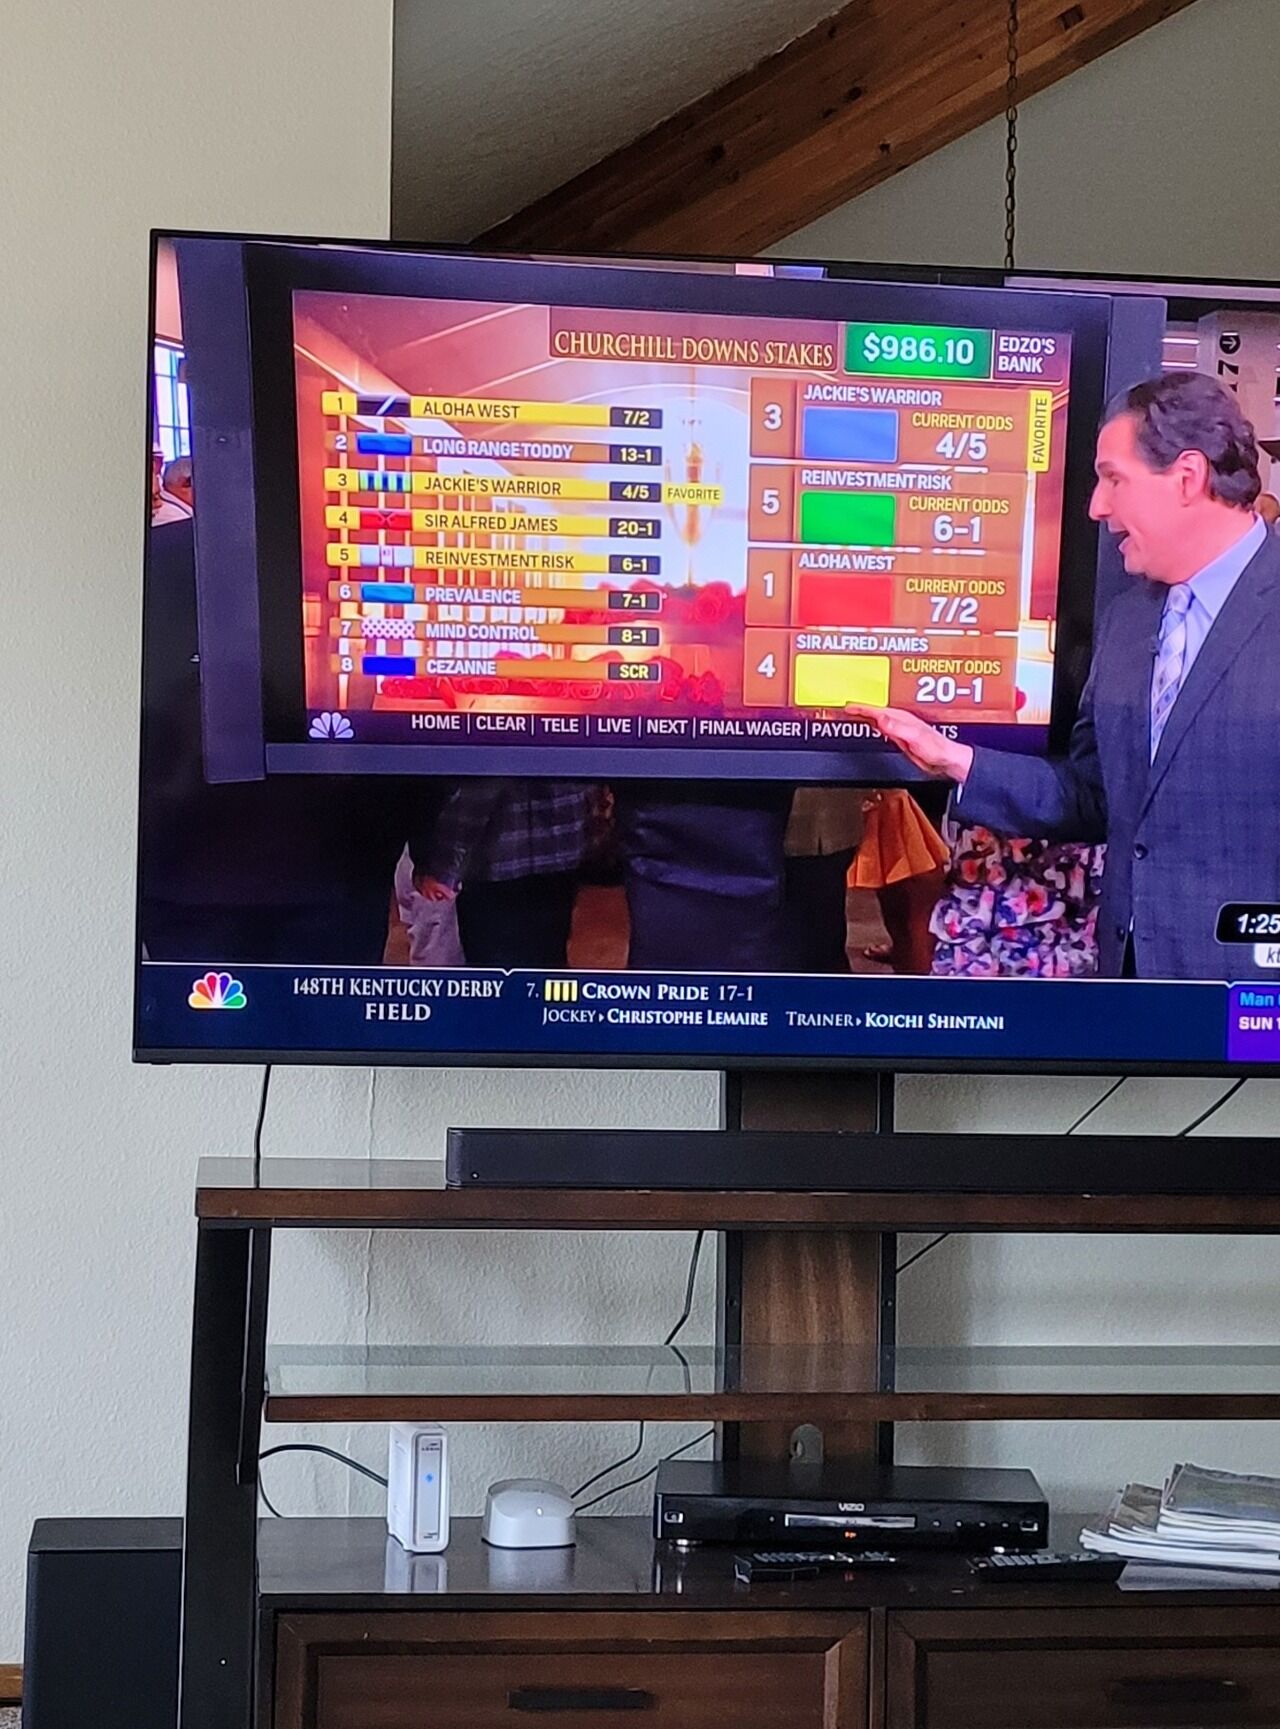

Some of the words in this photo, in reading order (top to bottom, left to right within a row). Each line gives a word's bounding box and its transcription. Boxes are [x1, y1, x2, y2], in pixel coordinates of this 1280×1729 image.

[554, 331, 677, 360] CHURCHILL
[682, 337, 759, 363] DOWNS
[764, 342, 833, 367] STAKES
[863, 331, 974, 365] $986.10
[999, 336, 1055, 355] EDZO'S
[998, 355, 1043, 374] BANK
[803, 384, 870, 402] JACKIE'S
[870, 387, 942, 406] WARRIOR
[337, 397, 343, 410] 1
[423, 402, 473, 417] ALOHA
[476, 404, 520, 419] WEST
[623, 410, 649, 425] 7/2
[763, 404, 782, 429] 3
[912, 412, 975, 430] CURRENT
[977, 415, 1014, 432] ODDS
[1032, 396, 1048, 464] FAVORITE
[335, 435, 348, 451] 2
[423, 439, 466, 456] LONG
[468, 440, 519, 458] RANGE
[519, 443, 573, 460] TODDY
[620, 447, 652, 462] 13-1
[935, 431, 988, 460] 4/5
[337, 473, 348, 487] 3
[424, 477, 489, 493] JACKIE'S
[492, 480, 562, 496] WARRIOR
[622, 485, 650, 500] 4/5
[666, 487, 721, 501] FAVORITE
[801, 469, 915, 489] REINVESTMENT
[917, 474, 952, 491] RISK
[762, 489, 780, 514] 5
[909, 495, 973, 513] CURRENT
[974, 498, 1009, 515] ODDS
[338, 511, 348, 524] 4
[424, 514, 449, 529] SIR
[452, 515, 507, 530] ALFRED
[509, 517, 559, 532] JAMES
[617, 521, 653, 536] 20-1
[933, 516, 981, 543] 6-1
[339, 548, 349, 561] 5
[425, 552, 539, 569] REINVESTMENT
[541, 555, 575, 570] RISK
[622, 558, 649, 572] 6-1
[799, 553, 851, 570] ALOHA
[850, 554, 895, 571] WEST
[763, 573, 774, 597] 1
[905, 578, 969, 595] CURRENT
[970, 579, 1005, 596] ODDS
[339, 585, 352, 600] 6
[425, 588, 521, 604] PREVALENCE
[622, 594, 648, 608] 7-1
[930, 596, 978, 623] 7/2
[340, 622, 352, 635] 7
[425, 623, 467, 639] MIND
[467, 624, 539, 642] CONTROL
[621, 629, 648, 643] 8-1
[796, 634, 823, 650] SIR
[823, 635, 878, 652] ALFRED
[878, 636, 928, 653] JAMES
[341, 657, 354, 673] 8
[426, 660, 497, 675] CEZANNE
[619, 664, 649, 679] SCR
[757, 654, 776, 678] 4
[902, 659, 964, 674] CURRENT
[965, 660, 1001, 675] ODDS
[916, 676, 982, 703] 20-1
[411, 715, 461, 730] HOME
[475, 716, 526, 732] CLEAR
[541, 718, 579, 733] TELE
[597, 719, 632, 734] LIVE
[646, 719, 688, 735] NEXT
[700, 720, 745, 736] FINAL
[746, 722, 802, 737] WAGER
[292, 977, 345, 997] 148TH
[349, 978, 443, 998] KENTUCKY
[446, 979, 504, 999] DERBY
[582, 982, 651, 1001] CROWN
[657, 984, 710, 1001] PRIDE
[718, 985, 754, 1002] 17-1
[1240, 992, 1274, 1007] Man
[365, 1003, 431, 1022] FIELD
[542, 1007, 597, 1025] JOCKEY
[607, 1008, 703, 1025] CHRISTOPHE
[707, 1009, 768, 1026] LEMAIRE
[786, 1010, 854, 1027] TRAINER
[865, 1012, 923, 1029] KOICHI
[927, 1013, 1005, 1030] SHINTANI
[1238, 1016, 1272, 1030] SUN
